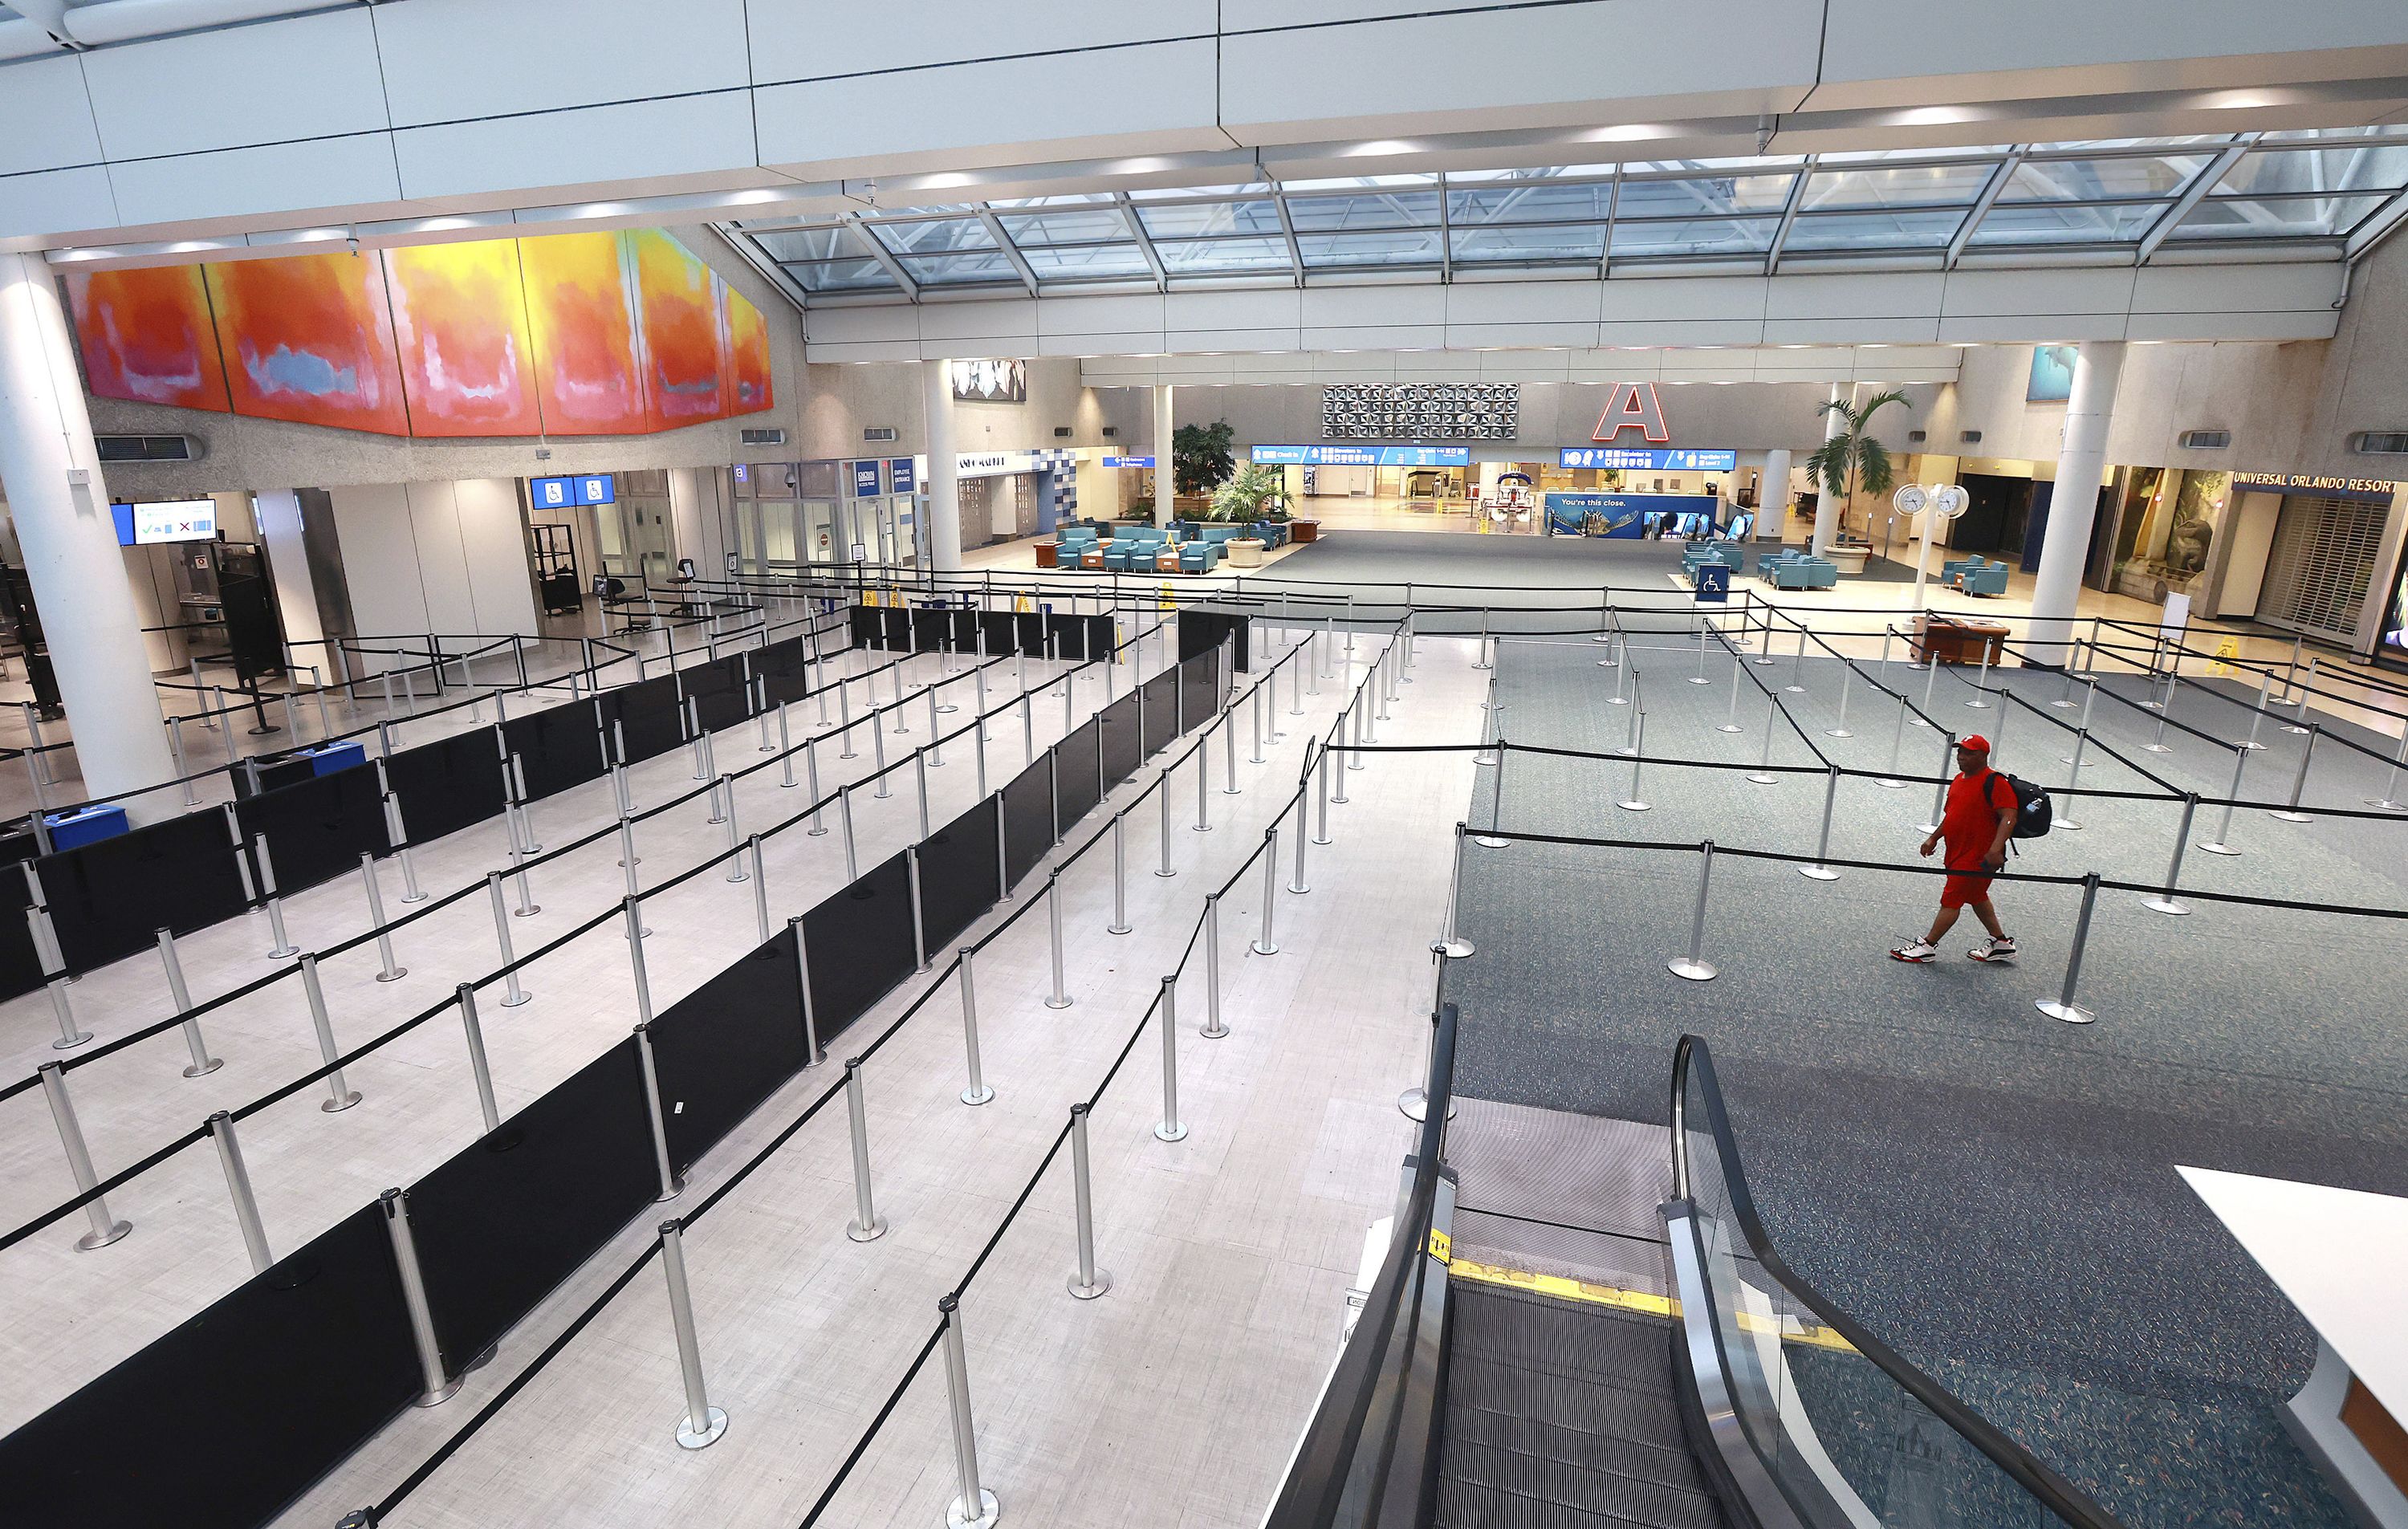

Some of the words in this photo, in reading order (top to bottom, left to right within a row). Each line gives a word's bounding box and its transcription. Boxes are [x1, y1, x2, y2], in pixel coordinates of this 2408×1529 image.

[1592, 383, 1670, 441] A
[2234, 472, 2288, 486] UNIVERSAL
[2290, 474, 2345, 490] ORLANDO
[2347, 478, 2398, 494] RESORT
